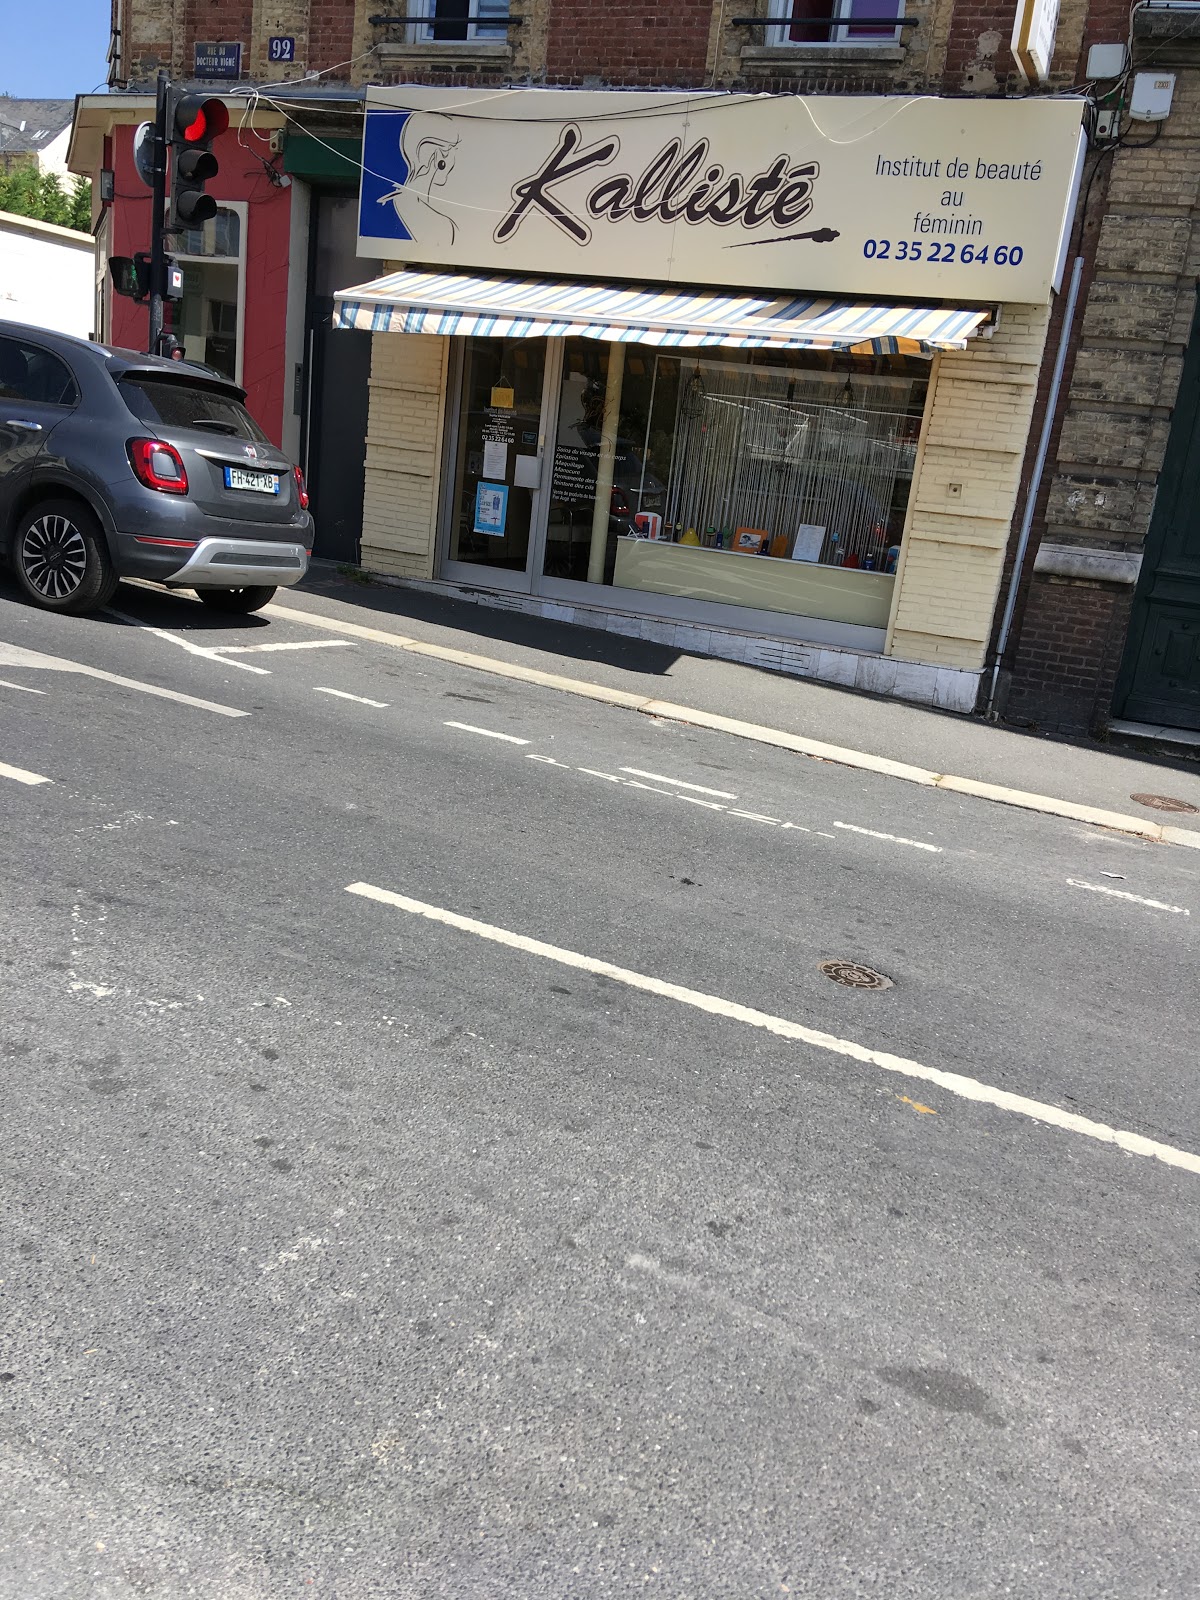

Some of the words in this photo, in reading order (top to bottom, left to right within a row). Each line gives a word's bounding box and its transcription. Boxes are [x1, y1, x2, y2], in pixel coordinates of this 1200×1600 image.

[207, 46, 217, 56] RUE
[219, 46, 226, 56] DU
[272, 39, 291, 59] 92
[196, 57, 219, 67] DOCTEUR
[875, 154, 942, 178] Institut
[946, 157, 969, 179] de
[975, 157, 1042, 181] beauté
[492, 122, 820, 247] Kallisté
[940, 190, 964, 207] au
[913, 212, 983, 235] féminin
[231, 470, 273, 489] FH-421-XB
